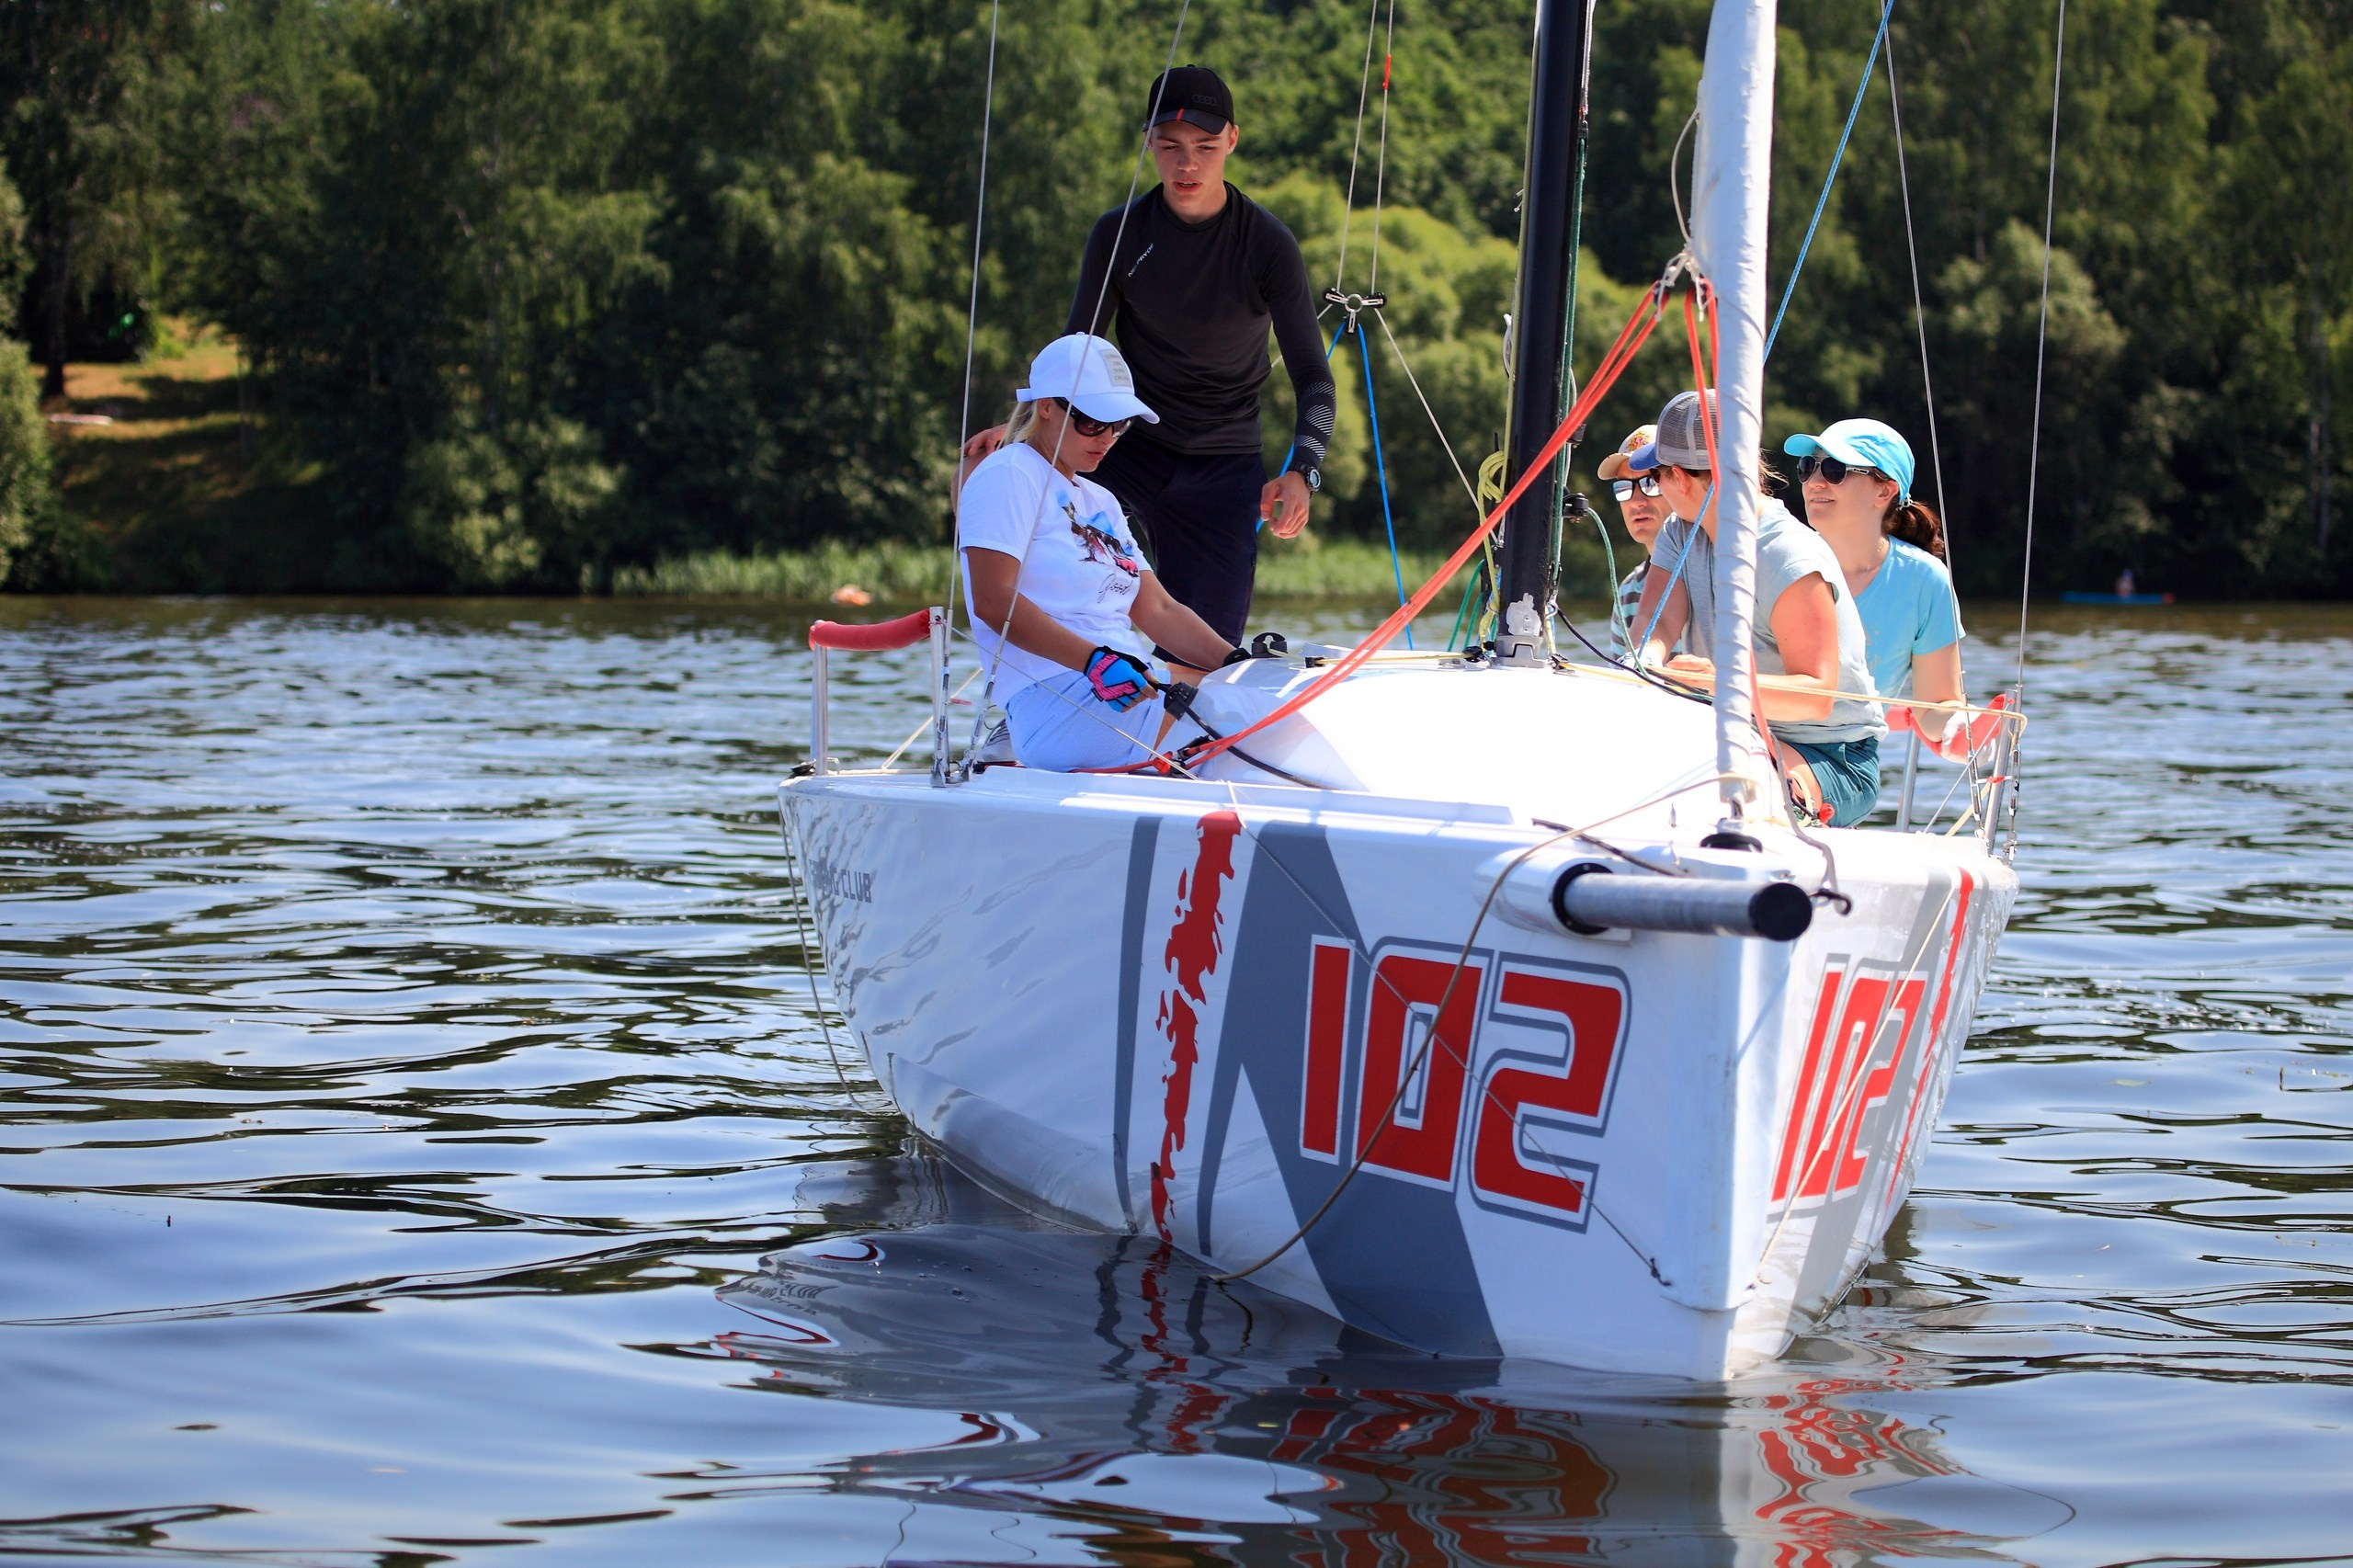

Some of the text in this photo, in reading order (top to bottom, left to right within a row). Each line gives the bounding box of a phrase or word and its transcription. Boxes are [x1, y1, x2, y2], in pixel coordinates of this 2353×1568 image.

[841, 869, 872, 903] CLUB
[1301, 938, 1628, 1227] 102
[1769, 965, 1927, 1206] 102
